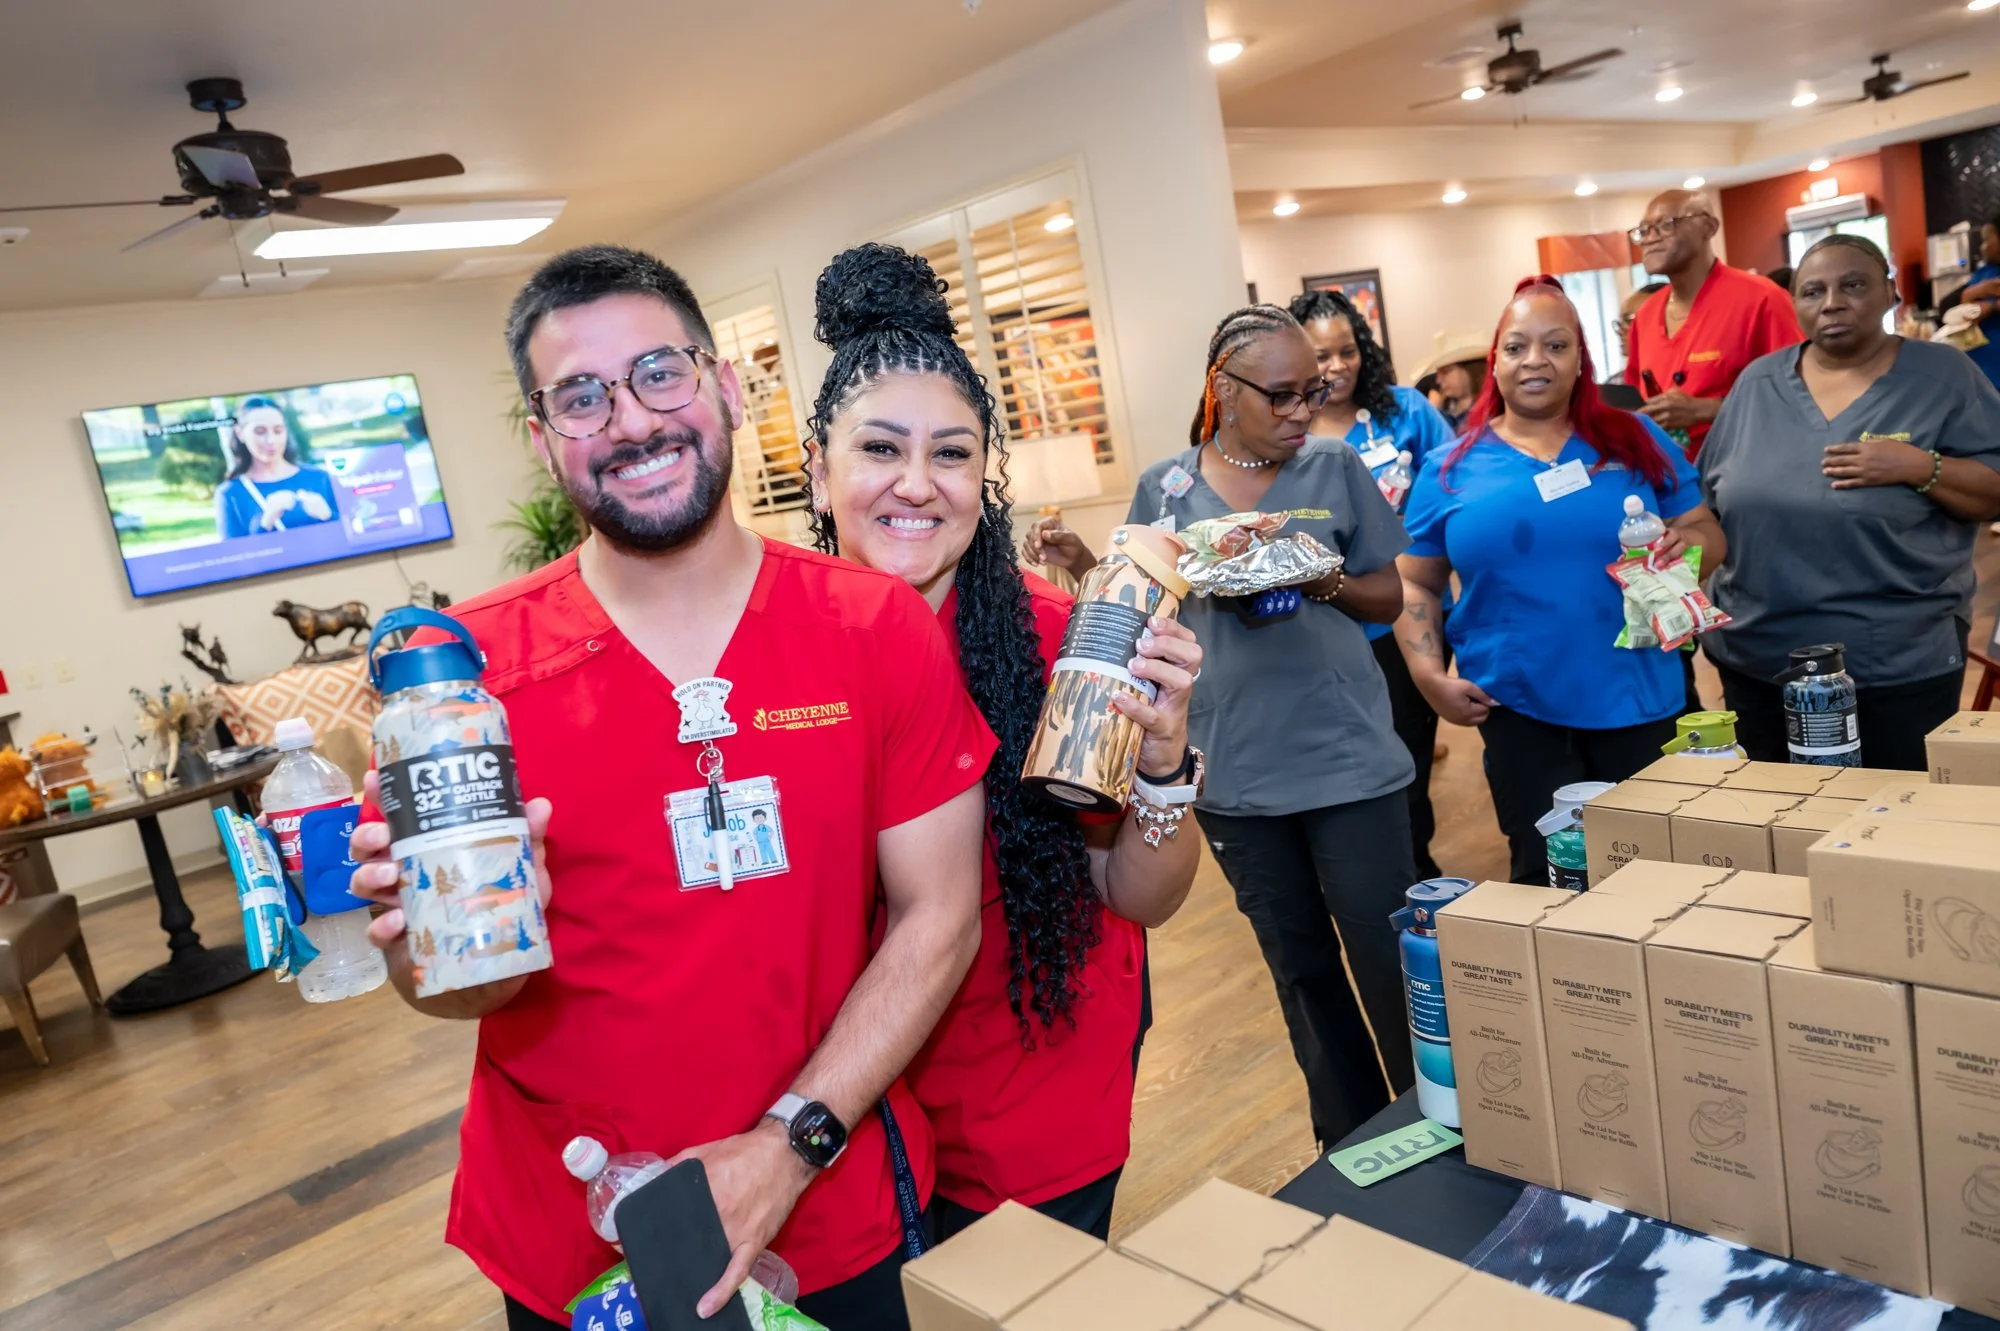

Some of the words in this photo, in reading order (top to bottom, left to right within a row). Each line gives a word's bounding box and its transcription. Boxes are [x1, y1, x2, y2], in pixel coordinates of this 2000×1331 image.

[676, 686, 692, 698] HOLD
[702, 680, 730, 690] PARTNER
[768, 701, 849, 722] CHEYENNE
[785, 720, 815, 730] MEDICAL
[816, 716, 838, 727] LODGE
[690, 726, 734, 740] OVERSTIMULATED
[408, 751, 500, 793] RTIC
[452, 779, 503, 796] OUTBACK
[414, 788, 444, 813] 32
[454, 790, 497, 806] BOTTLE
[272, 816, 302, 834] OZA
[703, 813, 746, 838] Job
[1608, 854, 1632, 863] CERA
[1452, 961, 1495, 974] DURABILITY
[1496, 968, 1522, 979] MEETS
[1464, 971, 1487, 980] GREAT
[1489, 976, 1512, 985] TASTE
[1553, 978, 1601, 993] DURABILITY
[1603, 987, 1632, 999] MEETS
[1566, 989, 1593, 999] GREAT
[1595, 994, 1621, 1006] TASTE
[1664, 998, 1718, 1015] DURABILITY
[1720, 1009, 1753, 1022] MEETS
[1680, 1010, 1709, 1022] GREAT
[1711, 1016, 1741, 1029] TASTE
[1788, 1022, 1849, 1039] DURABILITY
[1852, 1033, 1890, 1046] MEETS
[1805, 1035, 1840, 1047] GREAT
[1842, 1041, 1876, 1054] TASTE
[1937, 1047, 2000, 1066] DURABILIT
[1956, 1062, 1995, 1076] GREAT
[1353, 1130, 1446, 1174] RTIC
